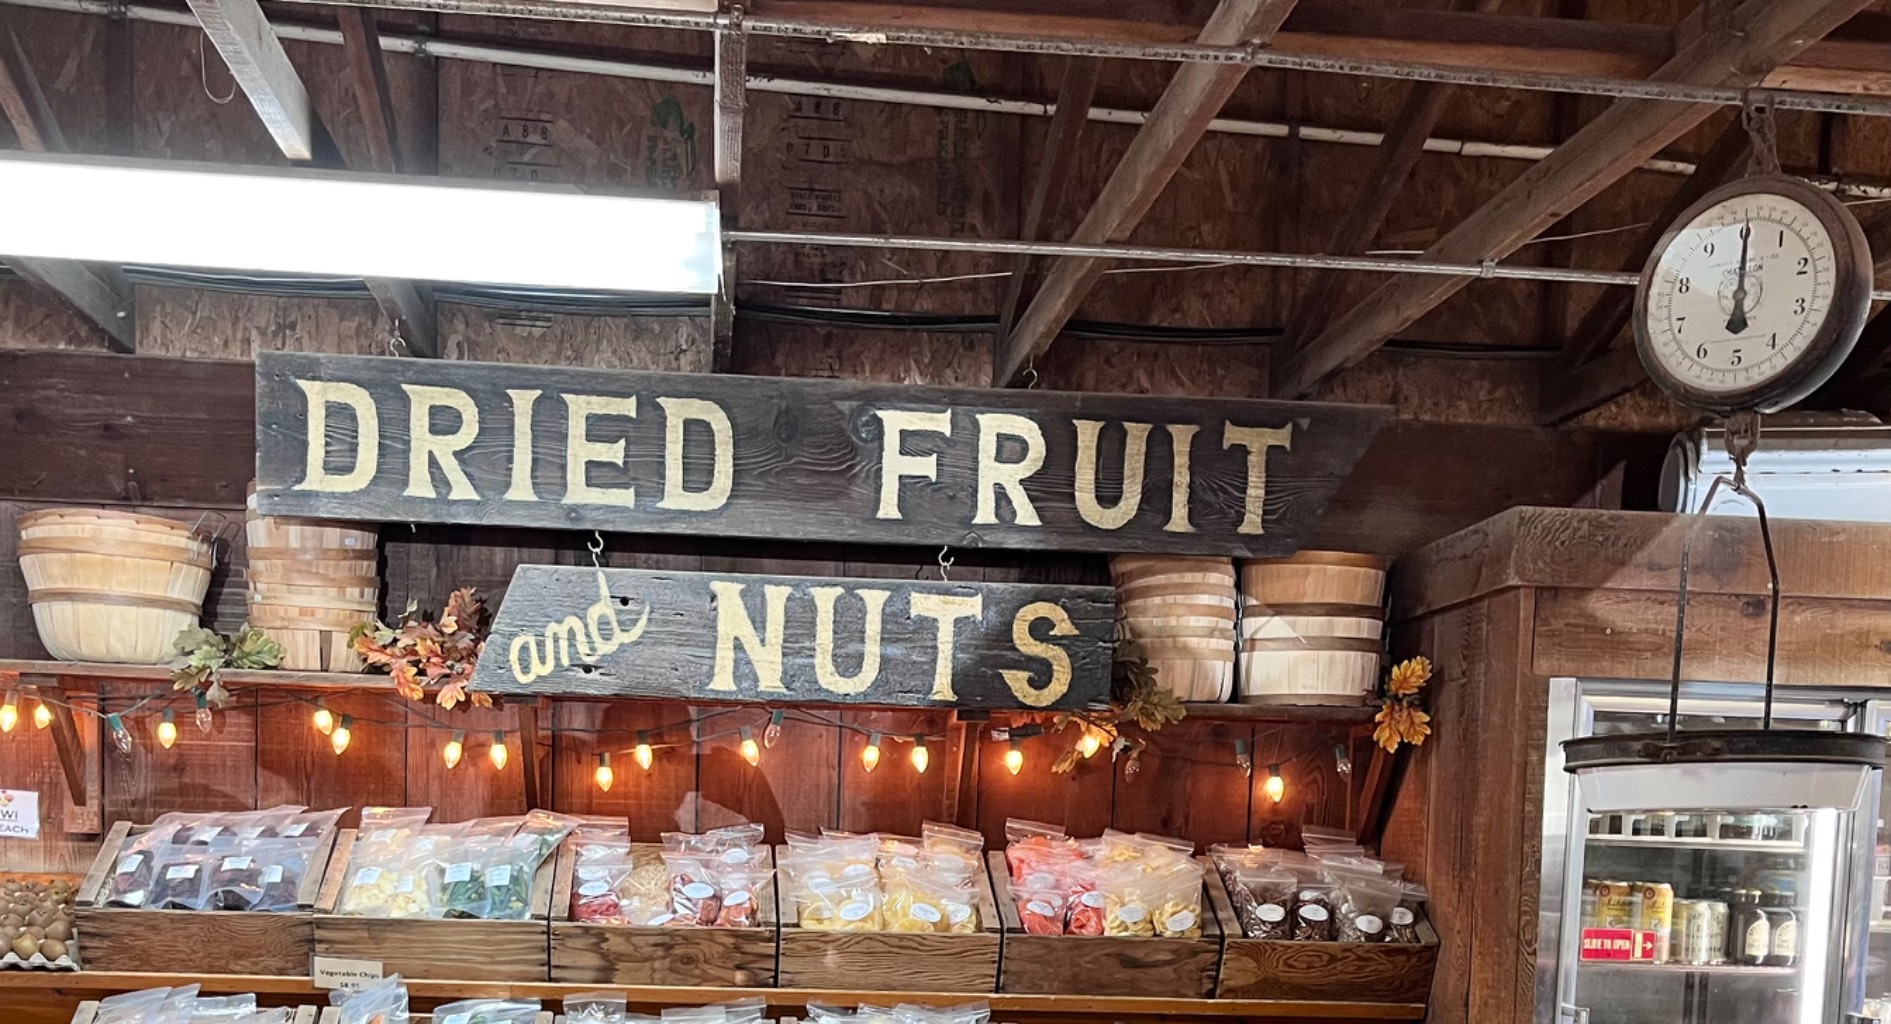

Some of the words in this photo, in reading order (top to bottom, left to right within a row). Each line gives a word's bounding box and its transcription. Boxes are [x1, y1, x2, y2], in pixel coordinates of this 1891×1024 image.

[1779, 230, 1784, 248] 1
[1703, 243, 1715, 258] 9
[1796, 257, 1809, 276] 2
[1679, 277, 1691, 294] 8
[1793, 297, 1806, 316] 3
[1676, 316, 1686, 334] 7
[1696, 341, 1708, 360] 6
[1766, 333, 1777, 351] 4
[1730, 349, 1743, 366] 5
[295, 378, 734, 512] DRIED
[875, 408, 1294, 535] FRUIT
[508, 570, 650, 685] and
[706, 580, 1081, 708] NUTS
[1, 809, 18, 819] WI
[320, 969, 358, 978] Vegetable
[359, 971, 380, 979] Chips
